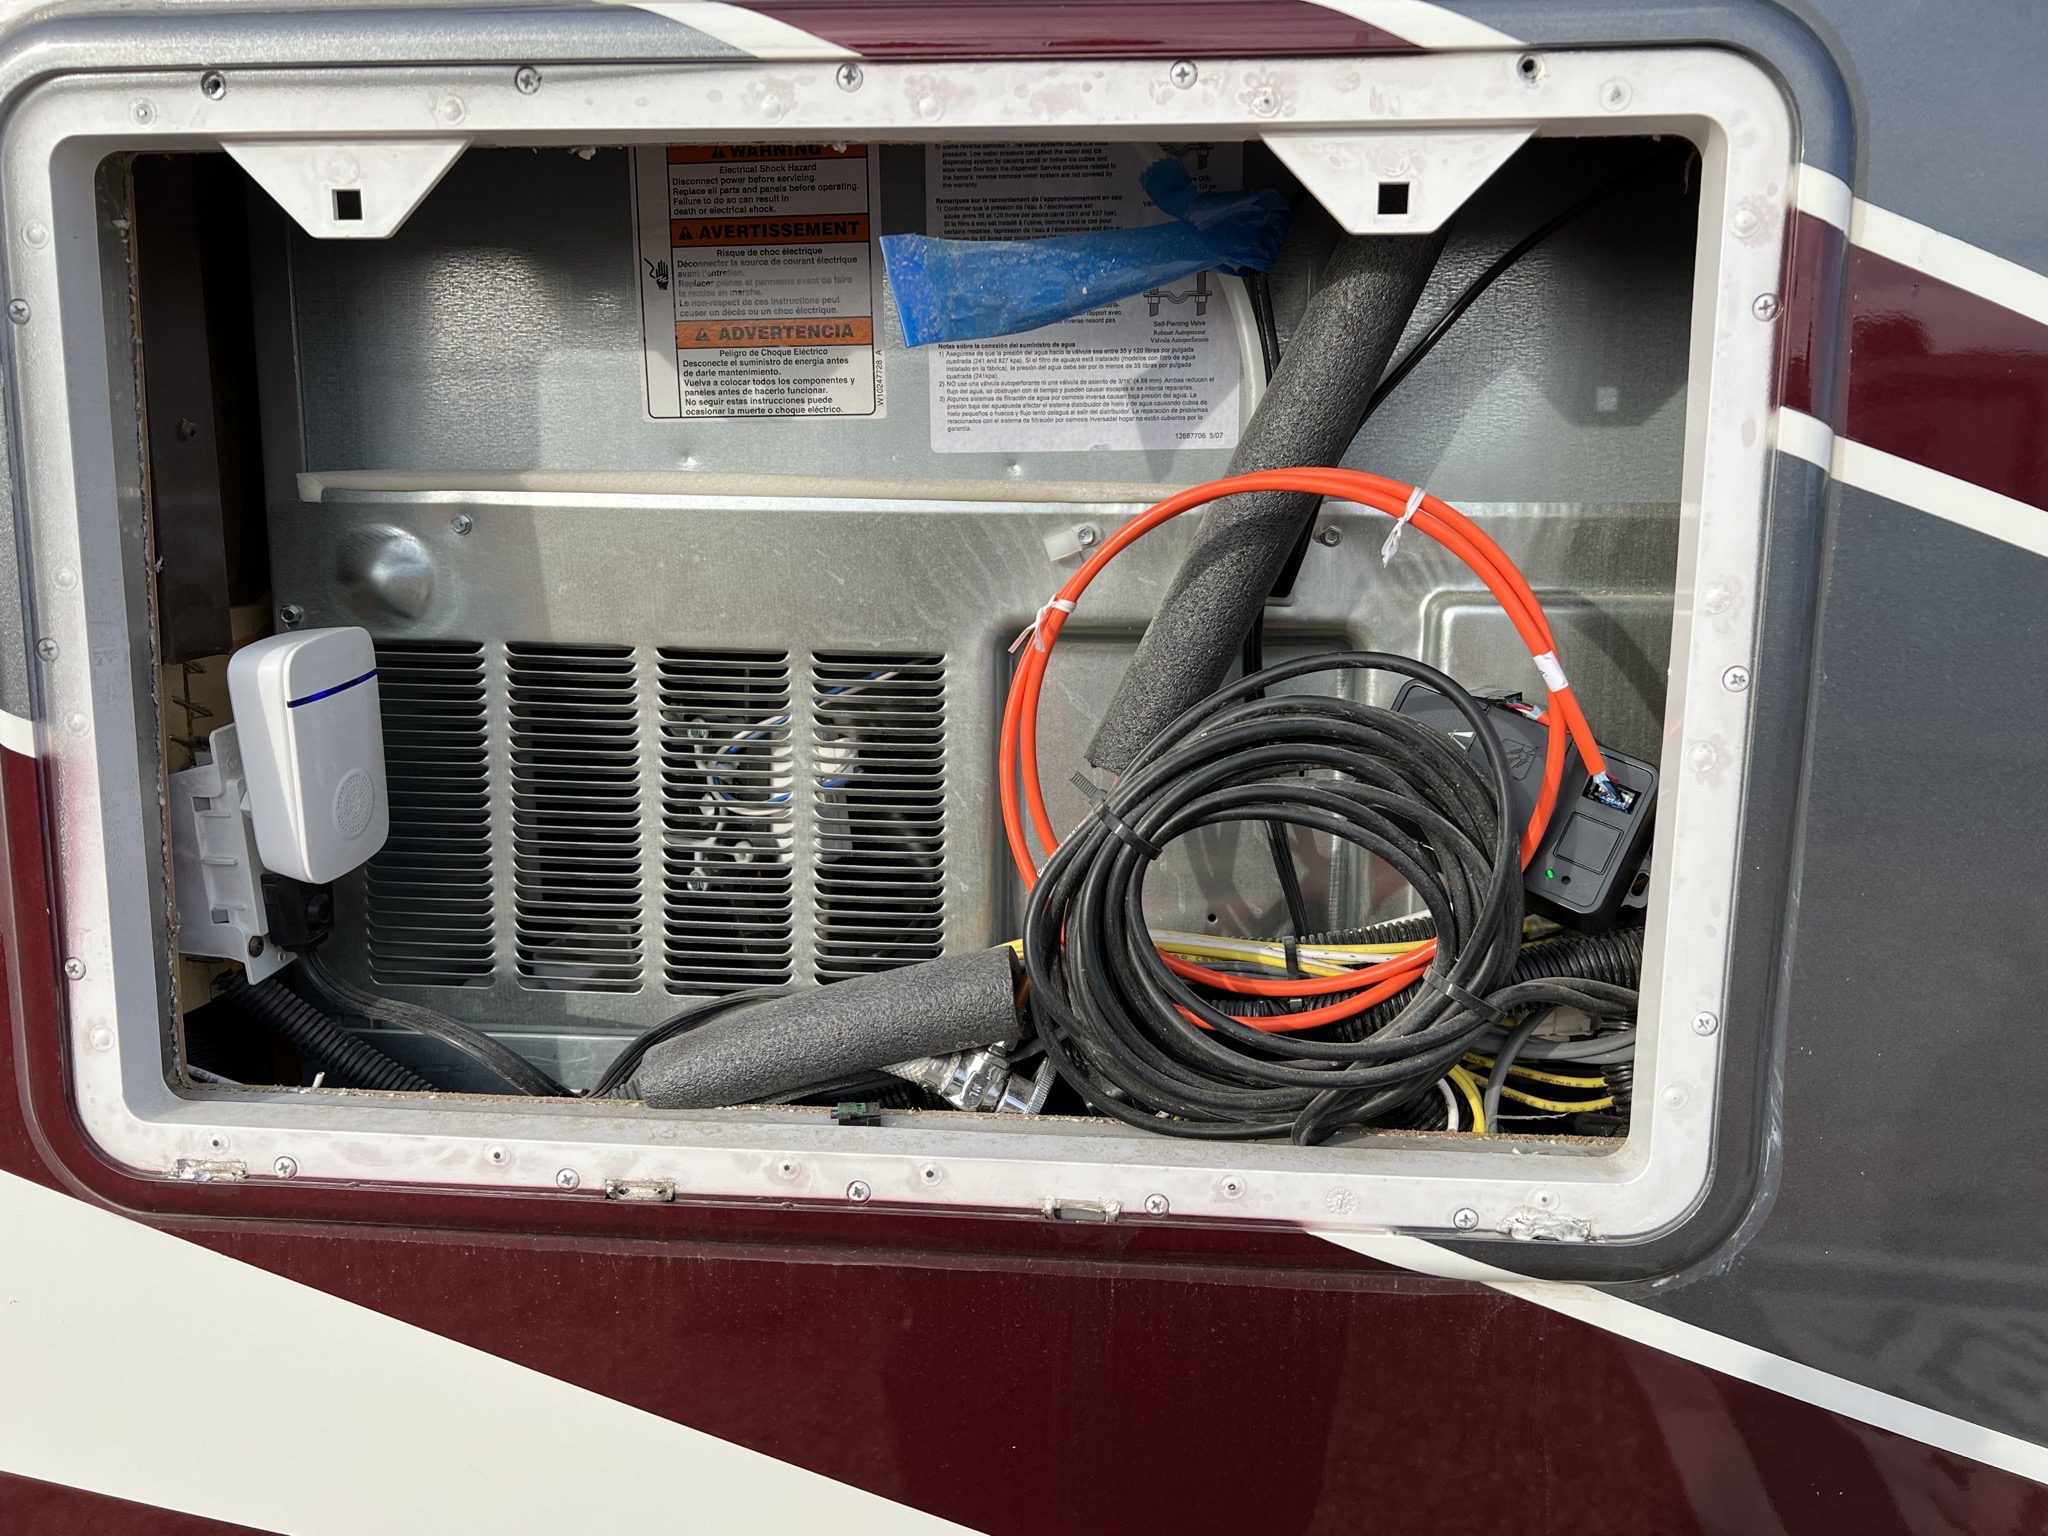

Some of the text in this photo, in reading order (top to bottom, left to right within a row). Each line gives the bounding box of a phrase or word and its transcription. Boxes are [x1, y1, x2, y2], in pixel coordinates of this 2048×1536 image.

[729, 145, 822, 158] WARNING
[719, 163, 817, 173] Electrical Shock Hazard
[672, 174, 817, 186] Disconnect power before servicing.
[672, 183, 860, 197] Replace all parts and panels before operating.
[673, 196, 702, 205] Failure
[702, 196, 713, 204] to
[712, 196, 724, 204] do
[755, 194, 779, 203] result
[781, 194, 789, 202] in
[673, 206, 697, 215] death
[709, 205, 747, 214] electrical
[748, 204, 776, 213] shock.
[699, 221, 861, 240] AVERTISSEMENT
[716, 247, 823, 258] Risque de choc électrique
[677, 259, 728, 268] Déconnecter
[730, 259, 738, 267] la
[770, 258, 781, 266] de
[782, 257, 814, 265] courant
[816, 256, 858, 266] électrique
[677, 269, 700, 277] avant
[796, 276, 820, 285] avant
[678, 289, 686, 297] la
[690, 298, 740, 309] non-respect
[741, 298, 752, 306] de
[770, 297, 820, 306] instructions
[821, 296, 840, 306] peut
[721, 308, 746, 316] décès
[773, 307, 794, 315] choc
[795, 306, 838, 316] électrique.
[1153, 320, 1189, 328] Self-Piercing
[718, 324, 855, 341] ADVERTENCIA
[719, 347, 828, 359] Peligro de Choque Eléctrico
[682, 359, 728, 367] Desconecte
[738, 358, 781, 366] suministro
[794, 357, 824, 367] energía
[826, 356, 850, 365] antes
[683, 368, 782, 377] de darle mantenimiento.
[684, 378, 711, 387] Vuelva
[719, 378, 750, 386] colocar
[752, 377, 776, 386] todos
[777, 377, 790, 385] los
[792, 376, 848, 387] componentes
[850, 378, 856, 386] y
[876, 359, 884, 406] W10247728
[684, 386, 828, 398] paneles antes de hacerlo funcionar.
[685, 396, 833, 407] No seguir estas instrucciones puede
[685, 407, 725, 415] ocasionar
[727, 407, 735, 415] la
[736, 406, 766, 414] muerte
[774, 406, 805, 416] choque
[807, 405, 844, 413] eléctrico.
